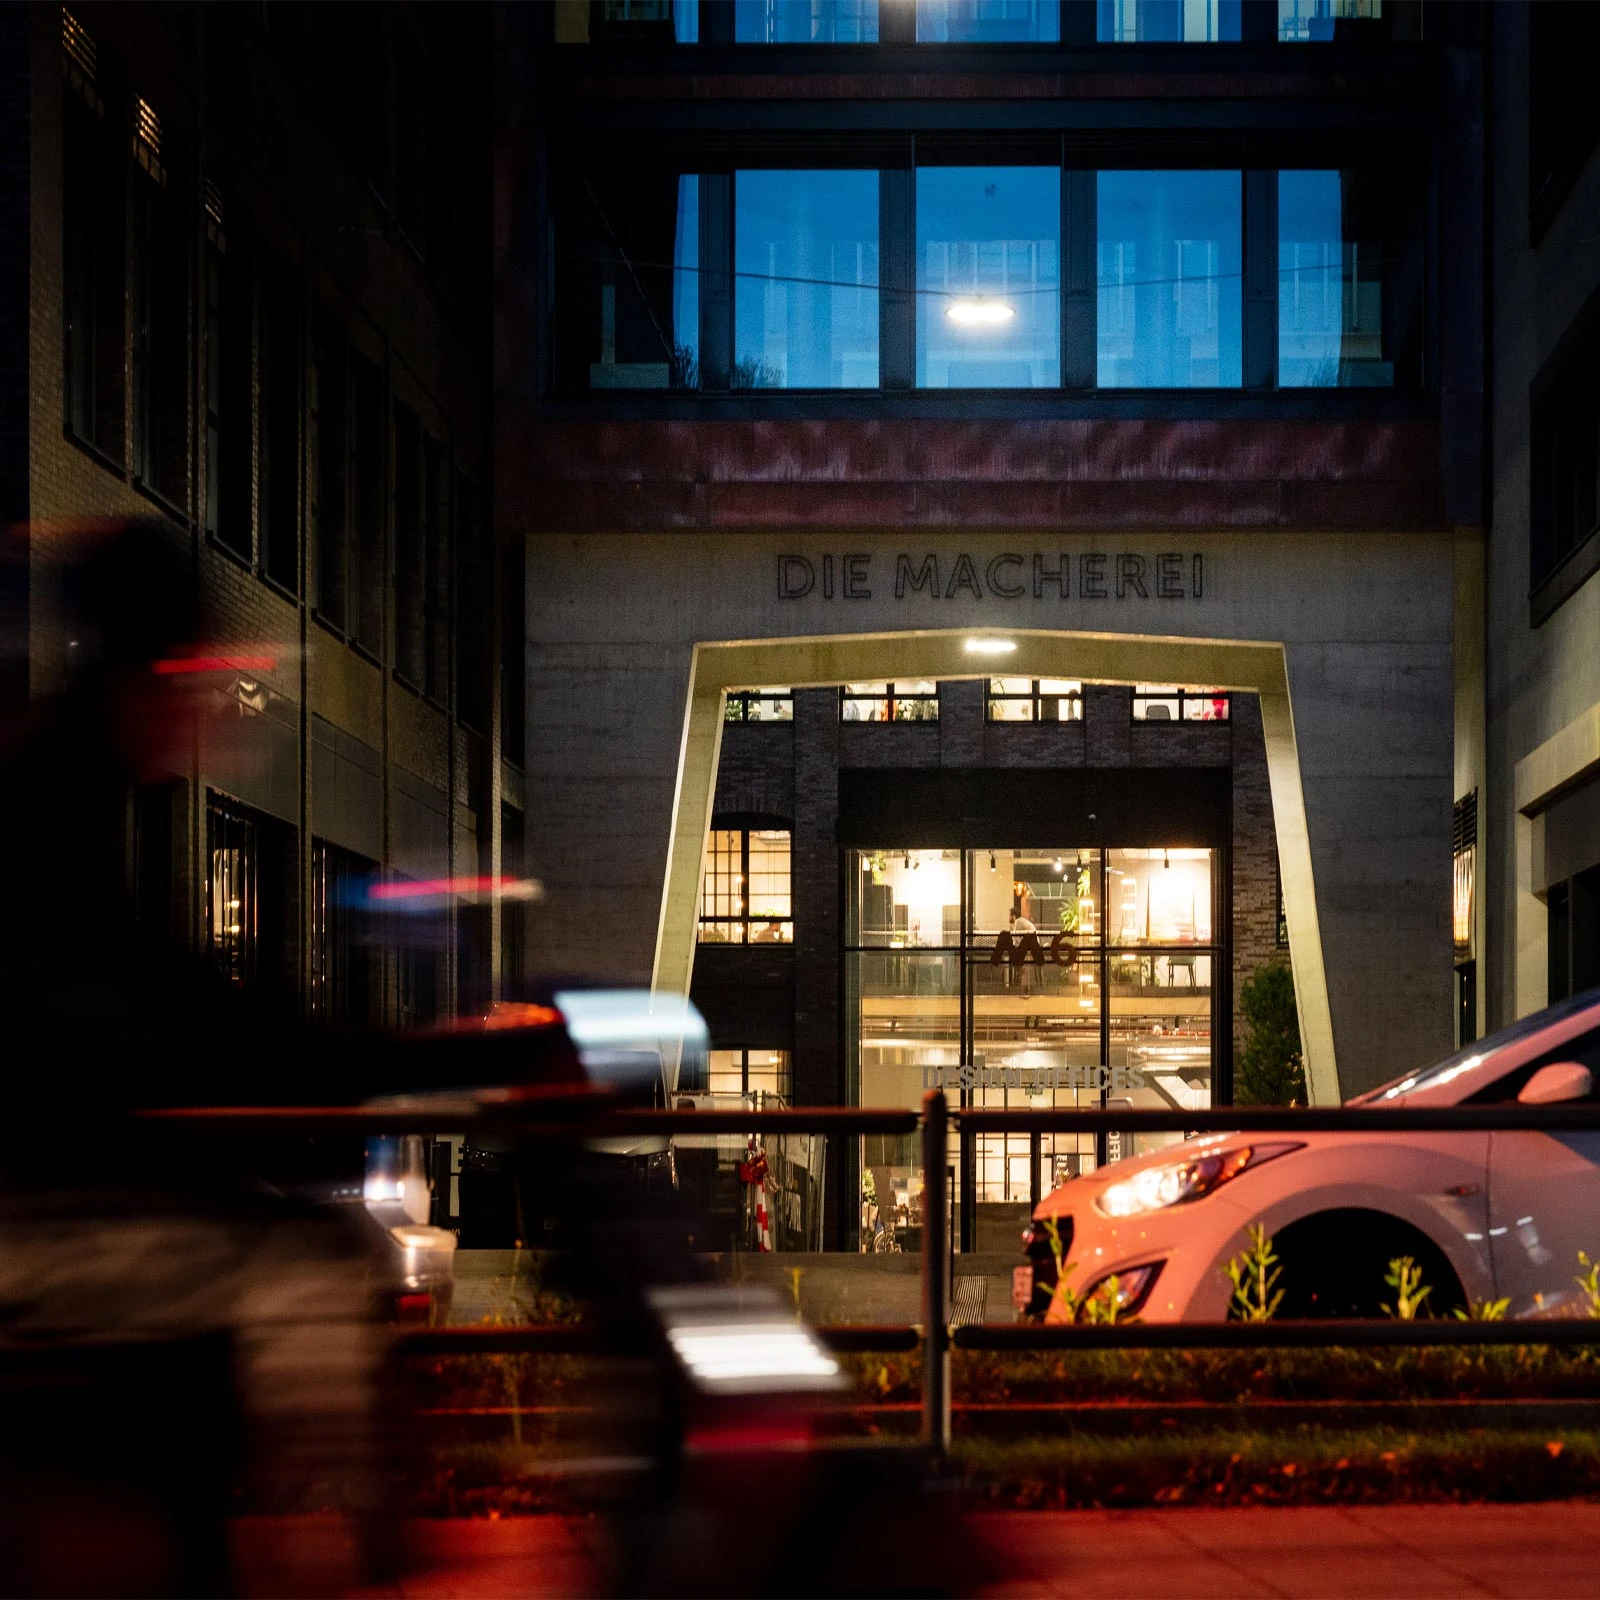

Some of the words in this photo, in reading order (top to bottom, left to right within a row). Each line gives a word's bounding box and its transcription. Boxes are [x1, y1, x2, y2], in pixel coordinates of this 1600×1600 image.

[777, 554, 872, 599] DIE
[895, 553, 1203, 599] MACHEREI
[990, 930, 1077, 966] M6
[922, 1065, 1021, 1090] DESIGN
[1035, 1065, 1145, 1091] OFFICES
